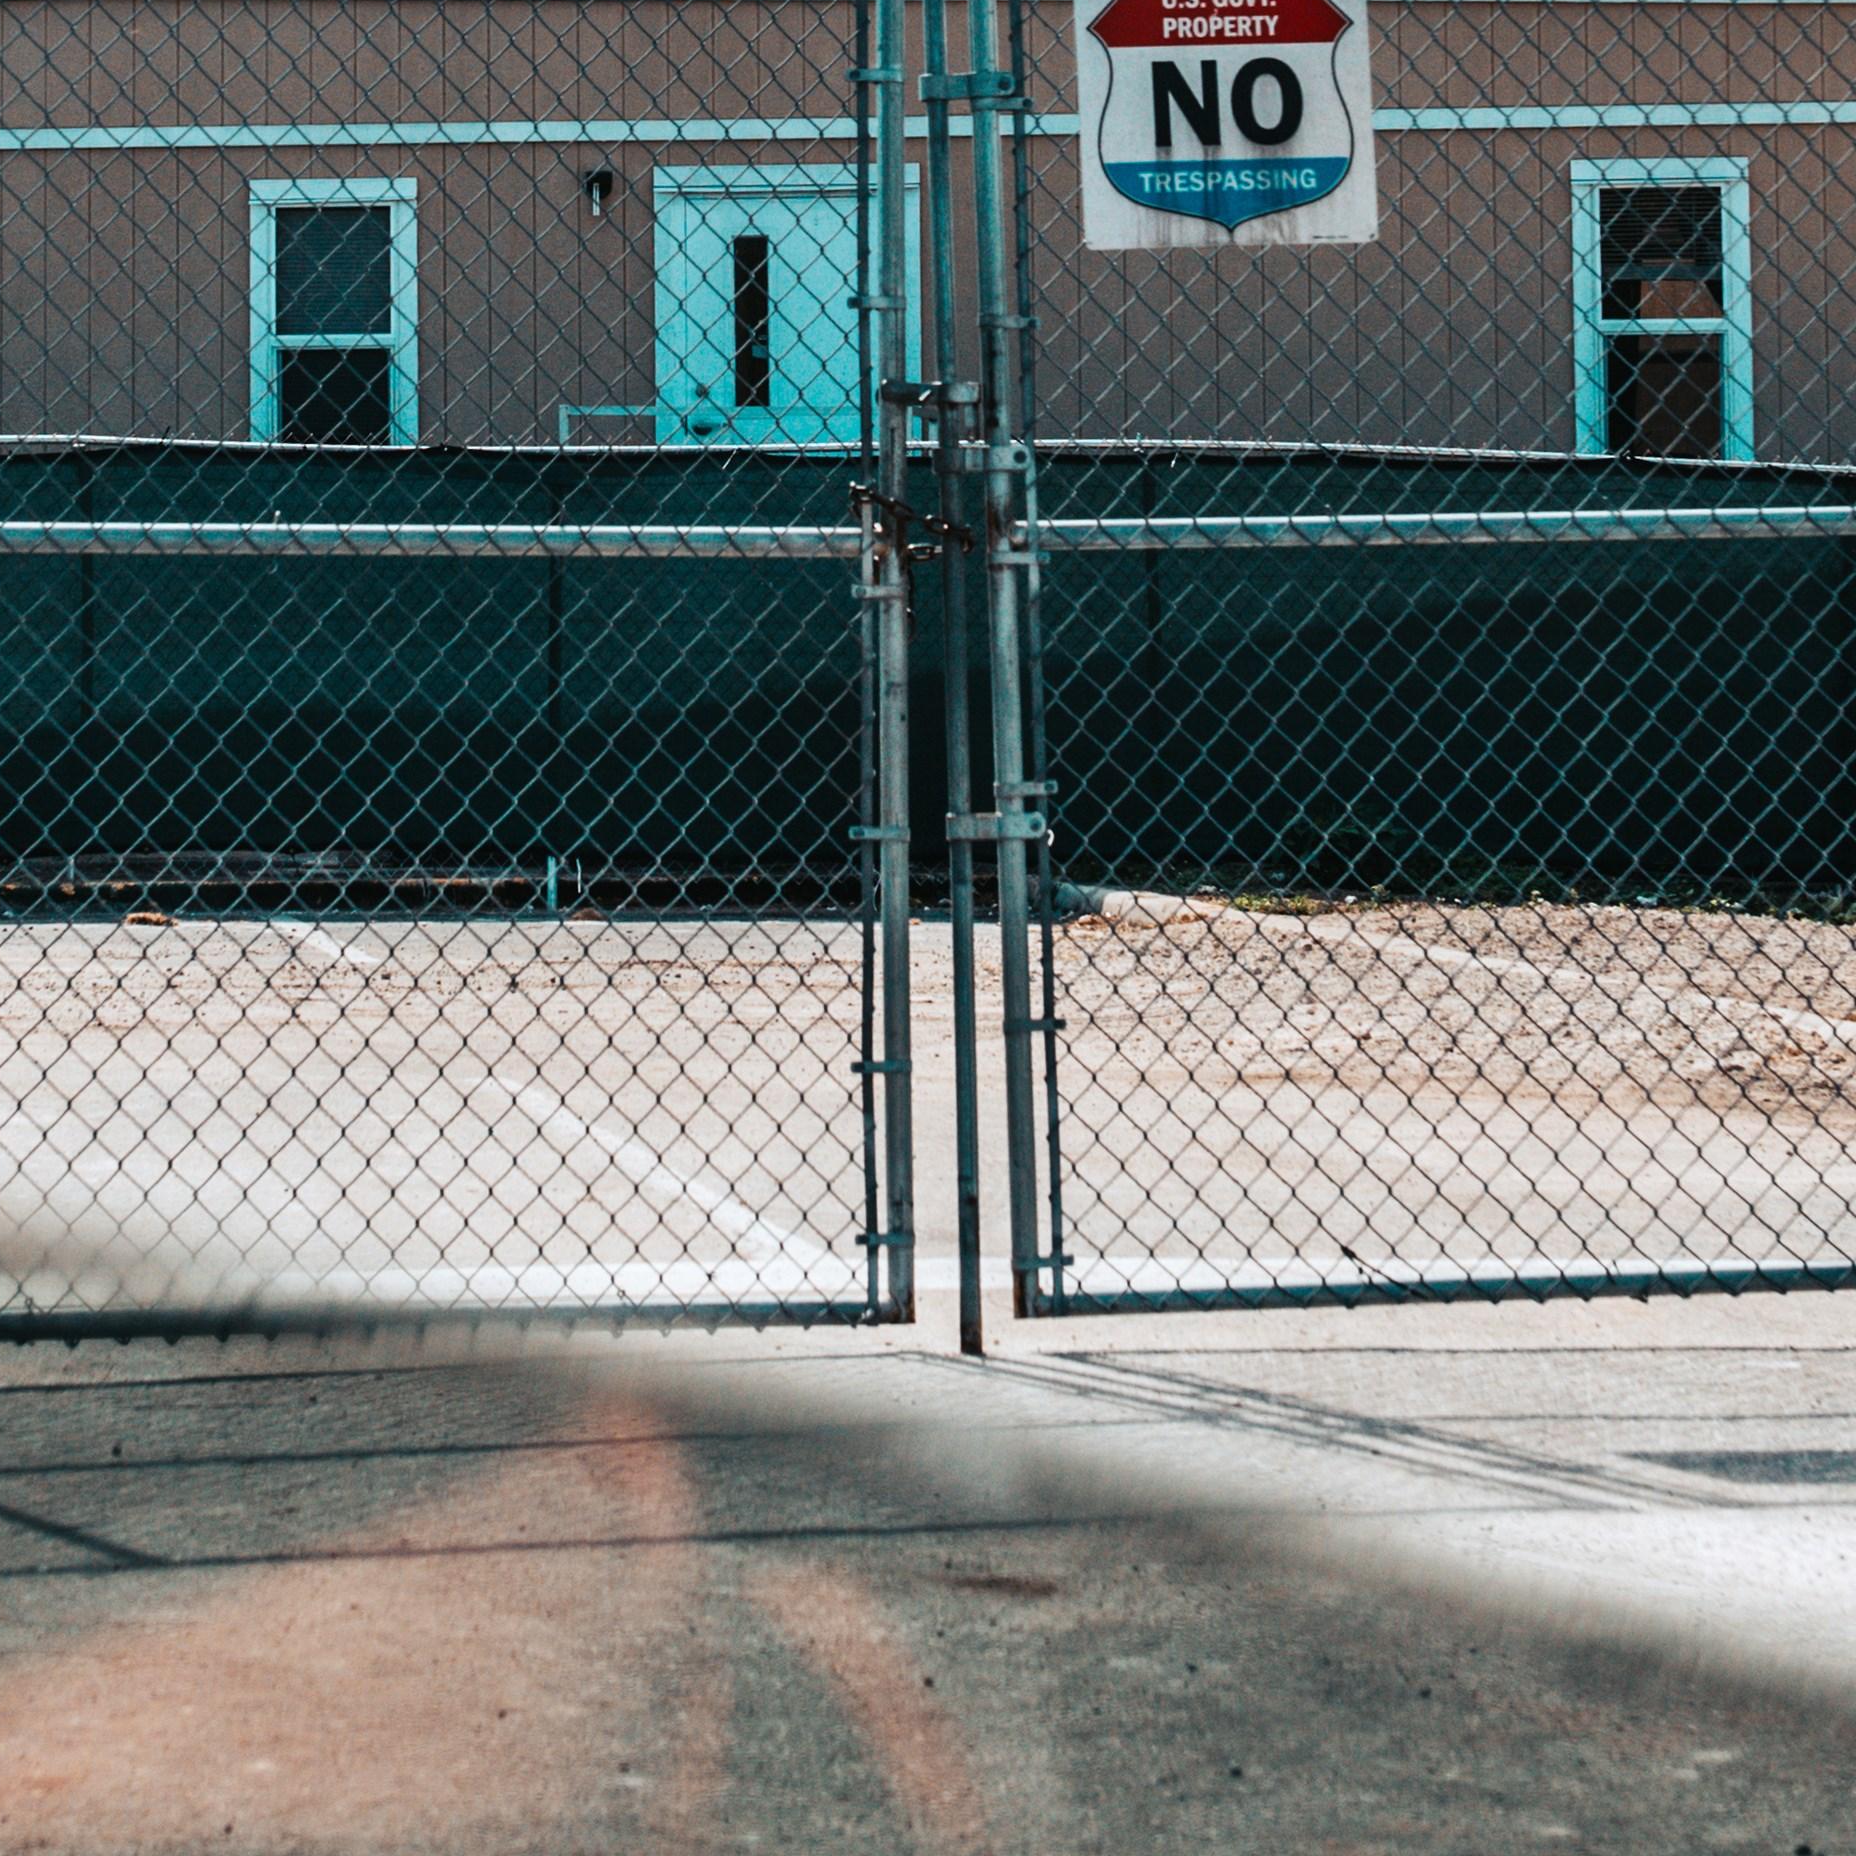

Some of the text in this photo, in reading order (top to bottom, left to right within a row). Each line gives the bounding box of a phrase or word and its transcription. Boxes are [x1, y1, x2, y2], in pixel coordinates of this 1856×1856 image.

[1162, 15, 1278, 38] PROPERTY
[1151, 57, 1303, 148] NO
[1139, 168, 1317, 192] TRESPASSING
